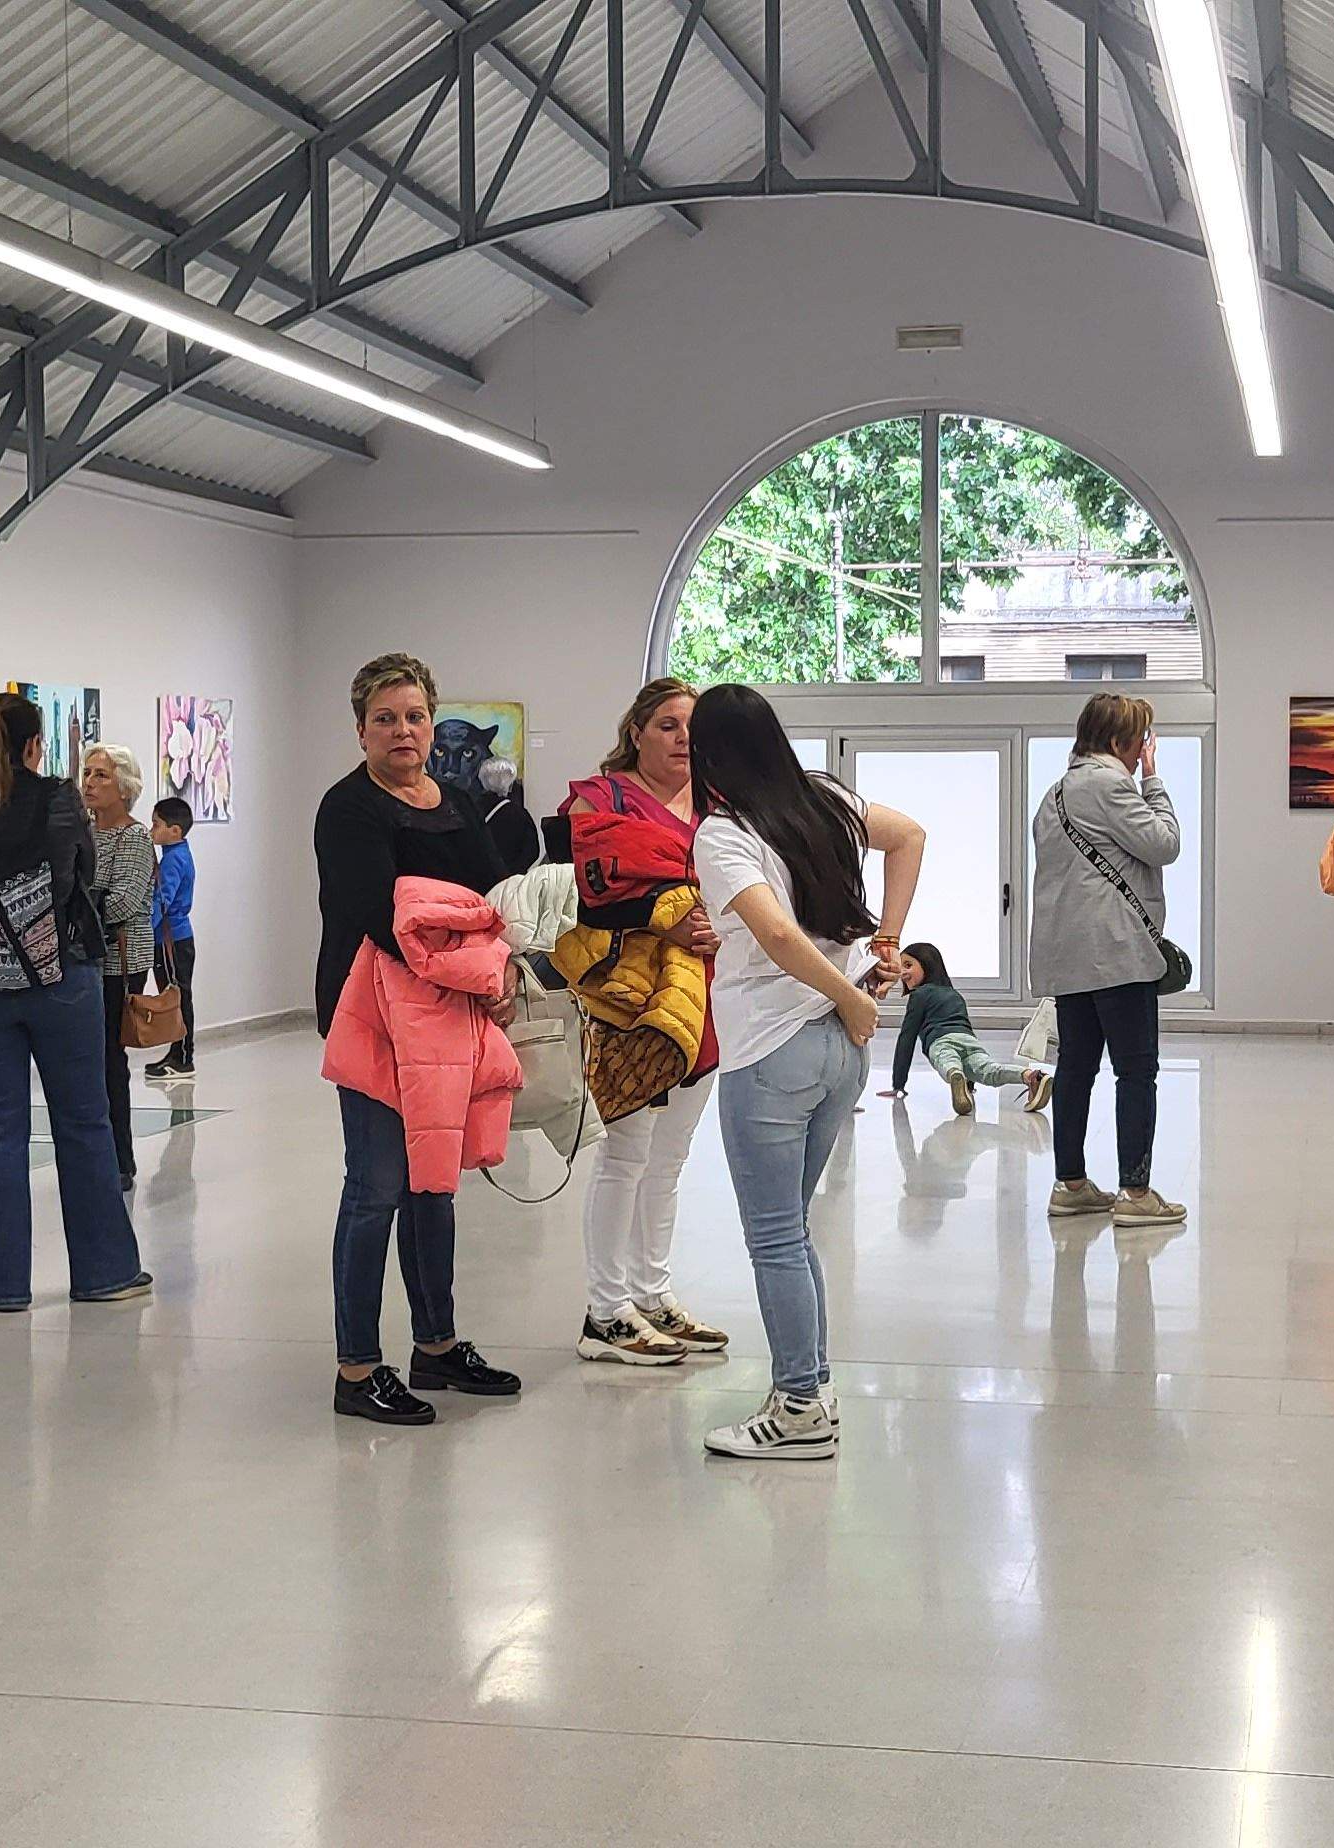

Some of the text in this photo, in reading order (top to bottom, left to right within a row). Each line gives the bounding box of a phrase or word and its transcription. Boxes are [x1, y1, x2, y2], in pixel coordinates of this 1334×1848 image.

[1067, 824, 1094, 856] BIMBA
[1094, 854, 1123, 886] BIMBA
[1123, 886, 1147, 919] BIMBA
